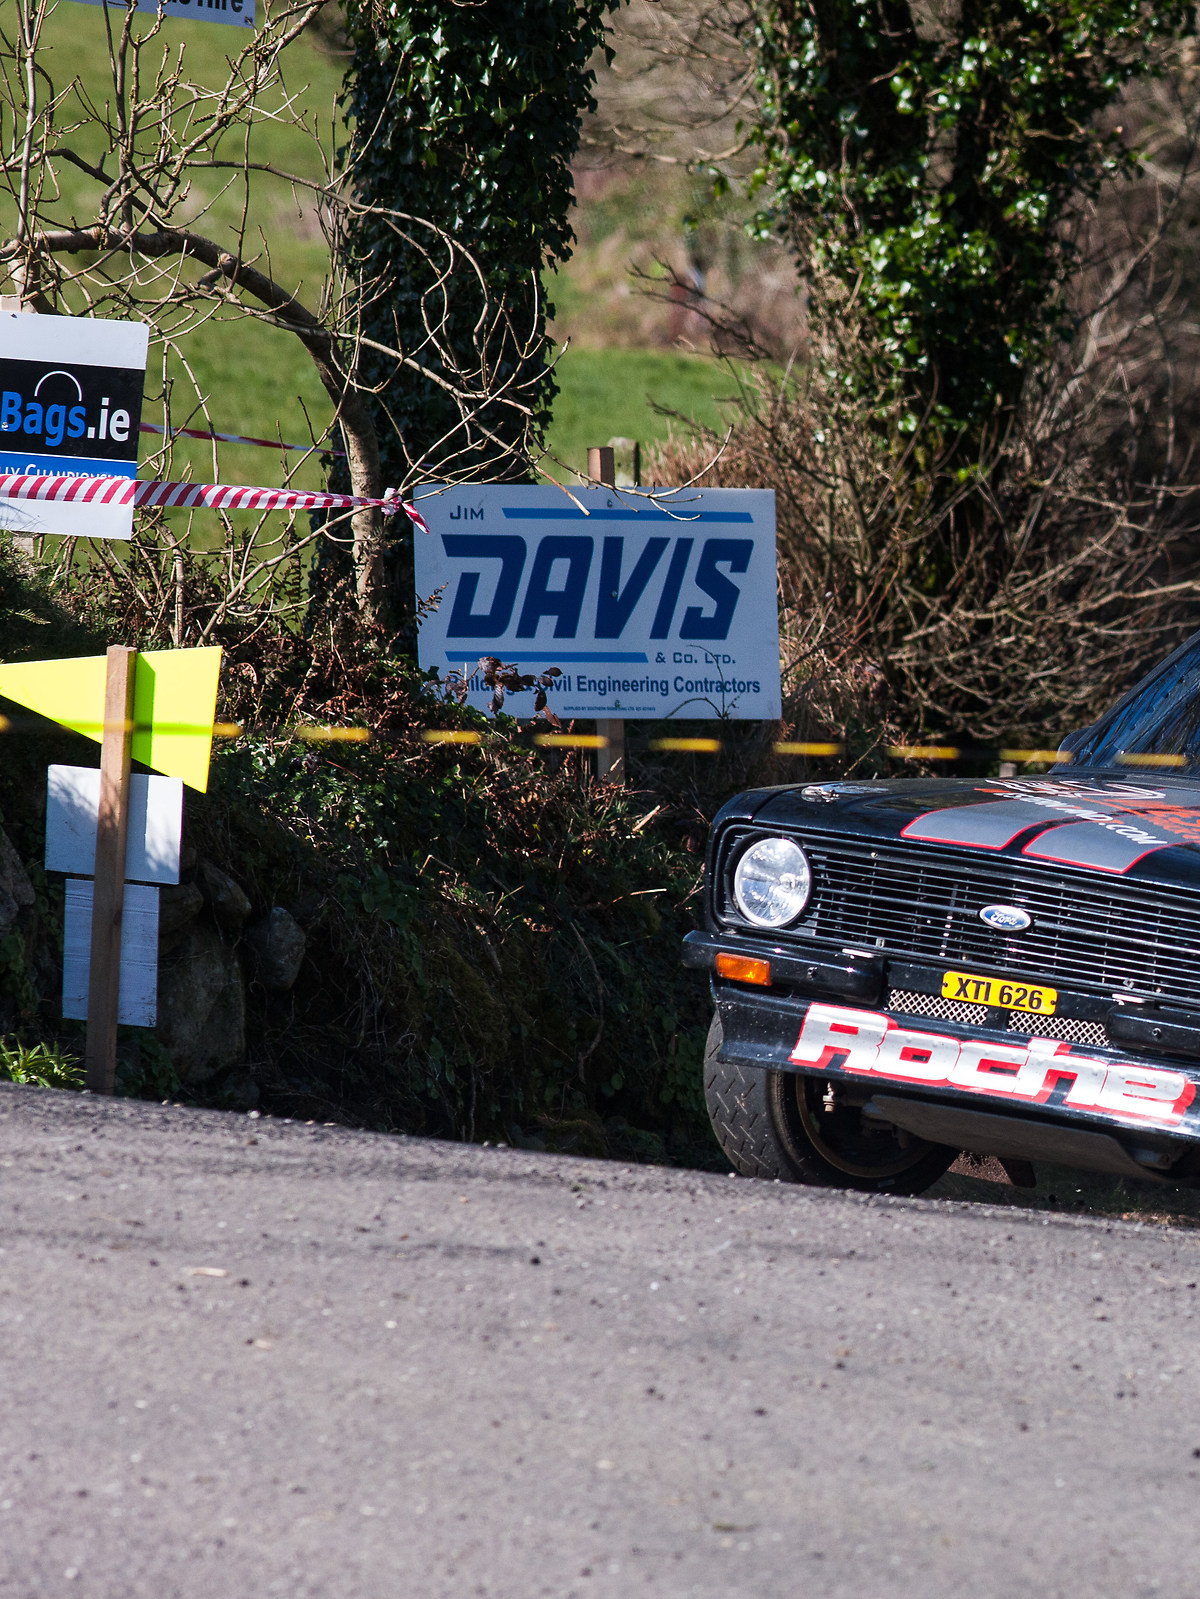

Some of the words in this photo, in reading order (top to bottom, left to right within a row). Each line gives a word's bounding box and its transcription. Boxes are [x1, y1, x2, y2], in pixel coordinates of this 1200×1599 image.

[1, 391, 131, 447] Bags.ie
[450, 505, 484, 520] JIM
[441, 534, 754, 640] DAVIS
[655, 652, 667, 664] &
[577, 675, 669, 697] Engineering
[673, 676, 761, 694] Contractors
[954, 976, 991, 1002] XTI
[999, 985, 1043, 1010] 626
[789, 1003, 1197, 1126] Roche
